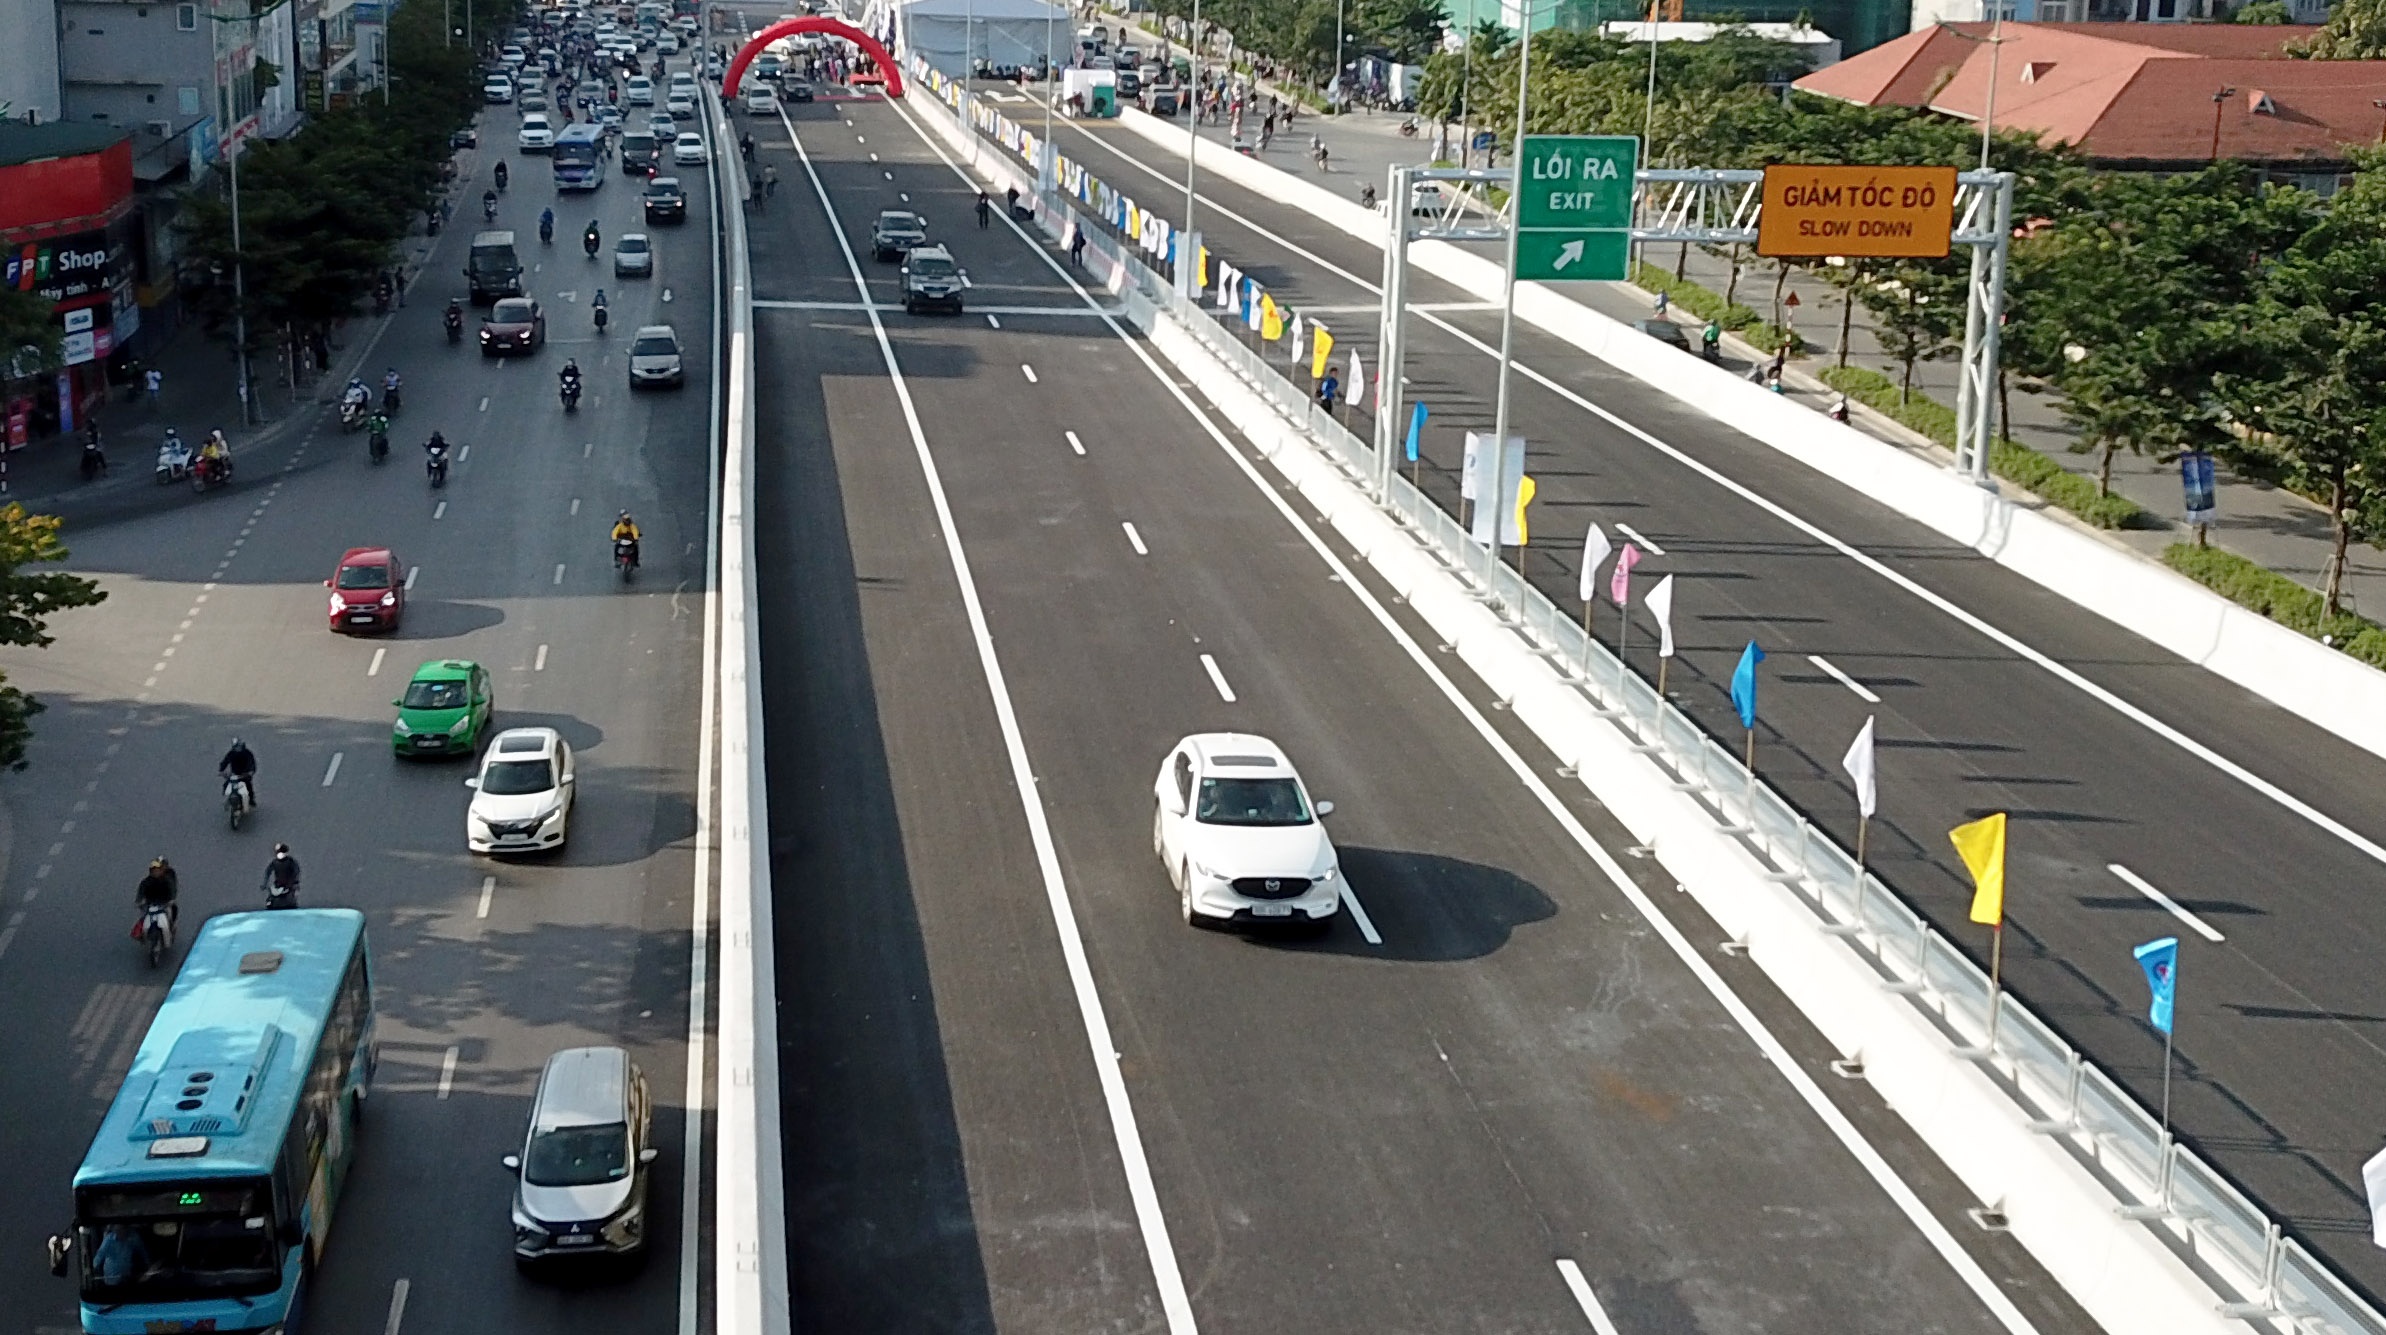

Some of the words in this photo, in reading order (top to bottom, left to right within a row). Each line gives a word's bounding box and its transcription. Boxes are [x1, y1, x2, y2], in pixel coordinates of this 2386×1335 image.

[1533, 147, 1572, 180] LỐI
[1583, 157, 1619, 180] RA
[1549, 191, 1596, 210] EXIT
[1783, 178, 1842, 208] GIẢM
[1847, 176, 1895, 208] TỐC
[1902, 181, 1936, 212] ĐỘ
[1798, 219, 1850, 237] SLOW
[1858, 220, 1913, 238] DOWN
[6, 255, 50, 280] FPT
[59, 250, 105, 271] Shop
